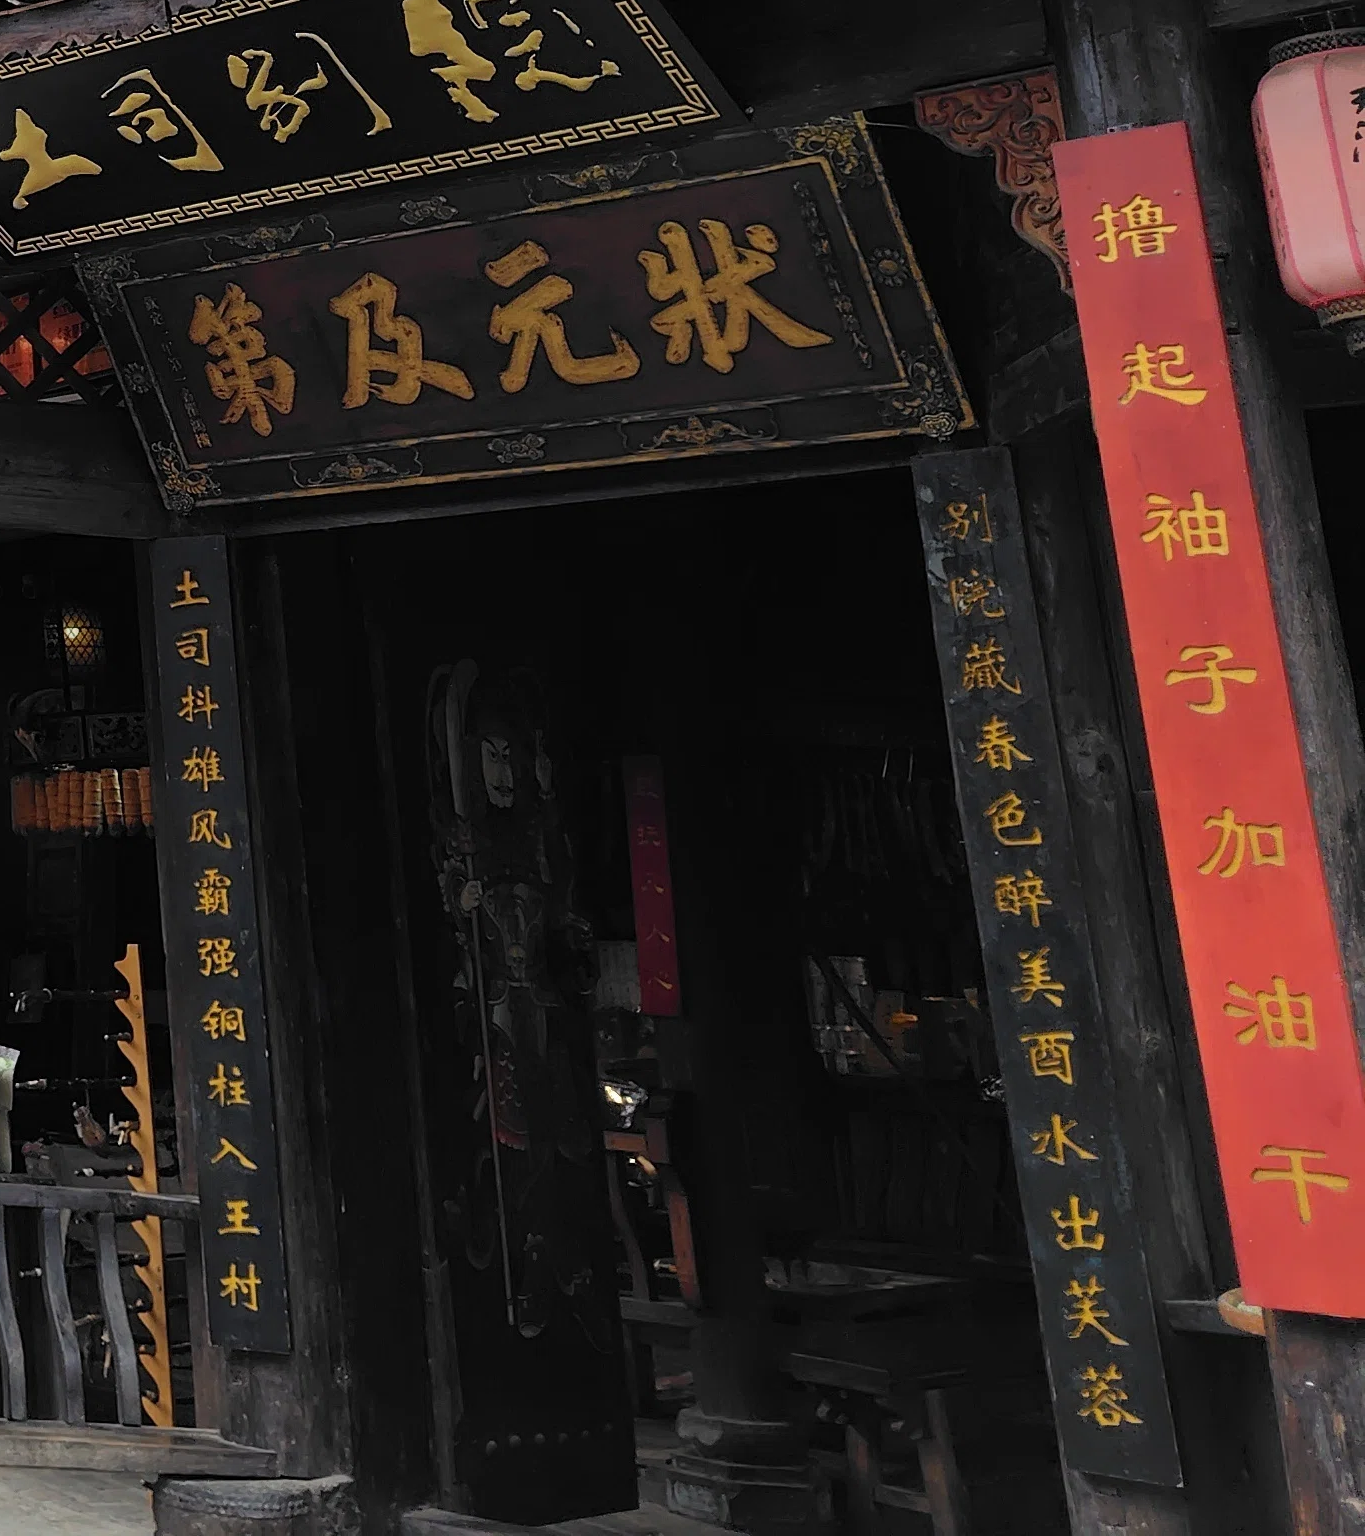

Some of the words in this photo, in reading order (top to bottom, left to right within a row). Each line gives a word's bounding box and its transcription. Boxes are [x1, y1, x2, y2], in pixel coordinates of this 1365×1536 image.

[1093, 196, 1350, 1226] 撸起袖子加油干
